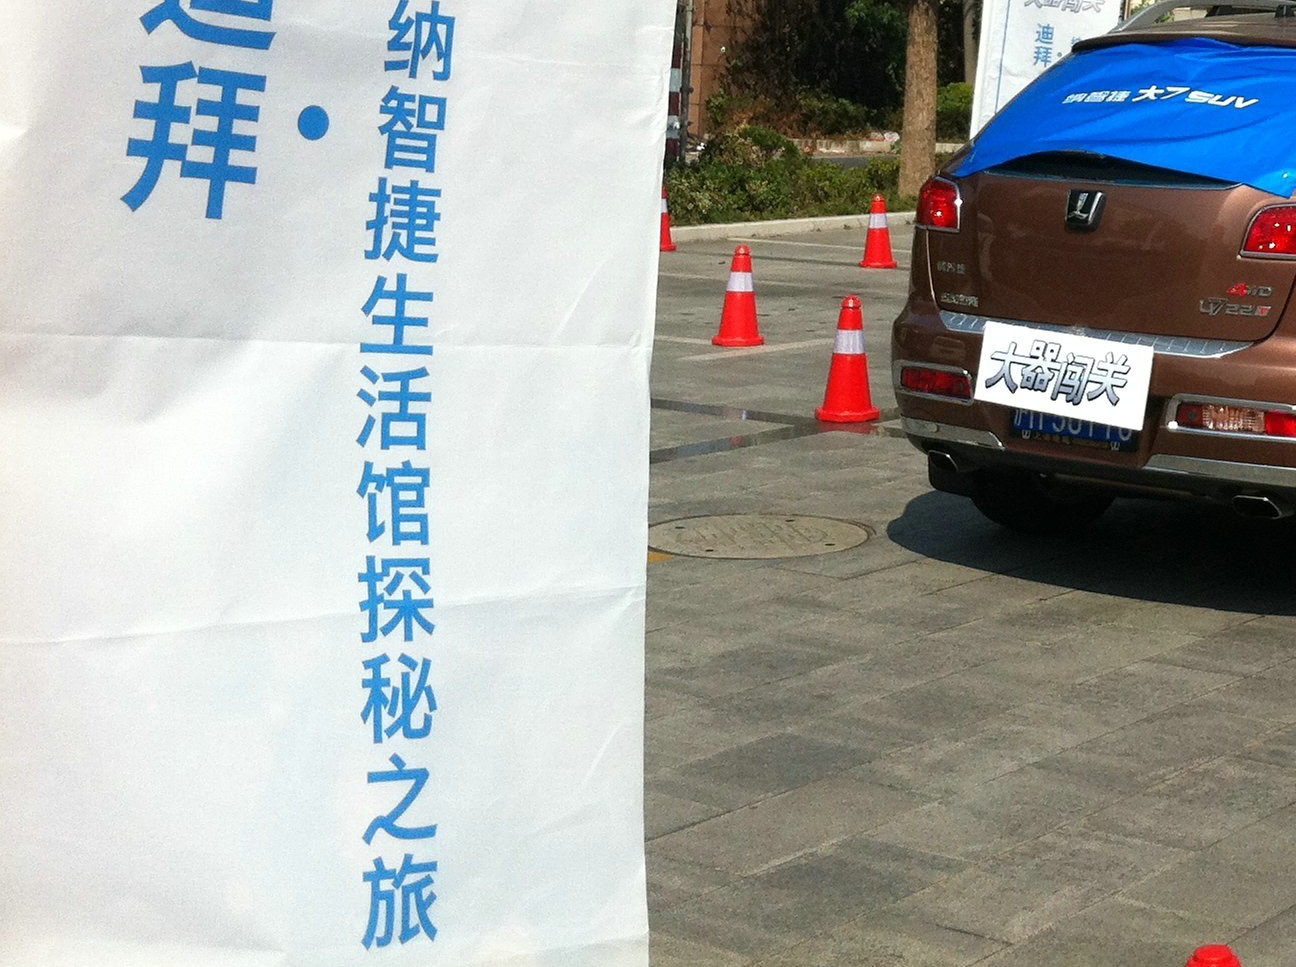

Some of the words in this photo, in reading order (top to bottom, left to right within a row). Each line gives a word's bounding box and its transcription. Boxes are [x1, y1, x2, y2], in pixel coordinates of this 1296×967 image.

[1185, 90, 1259, 109] SUV
[984, 339, 1131, 407] 大器闯关
